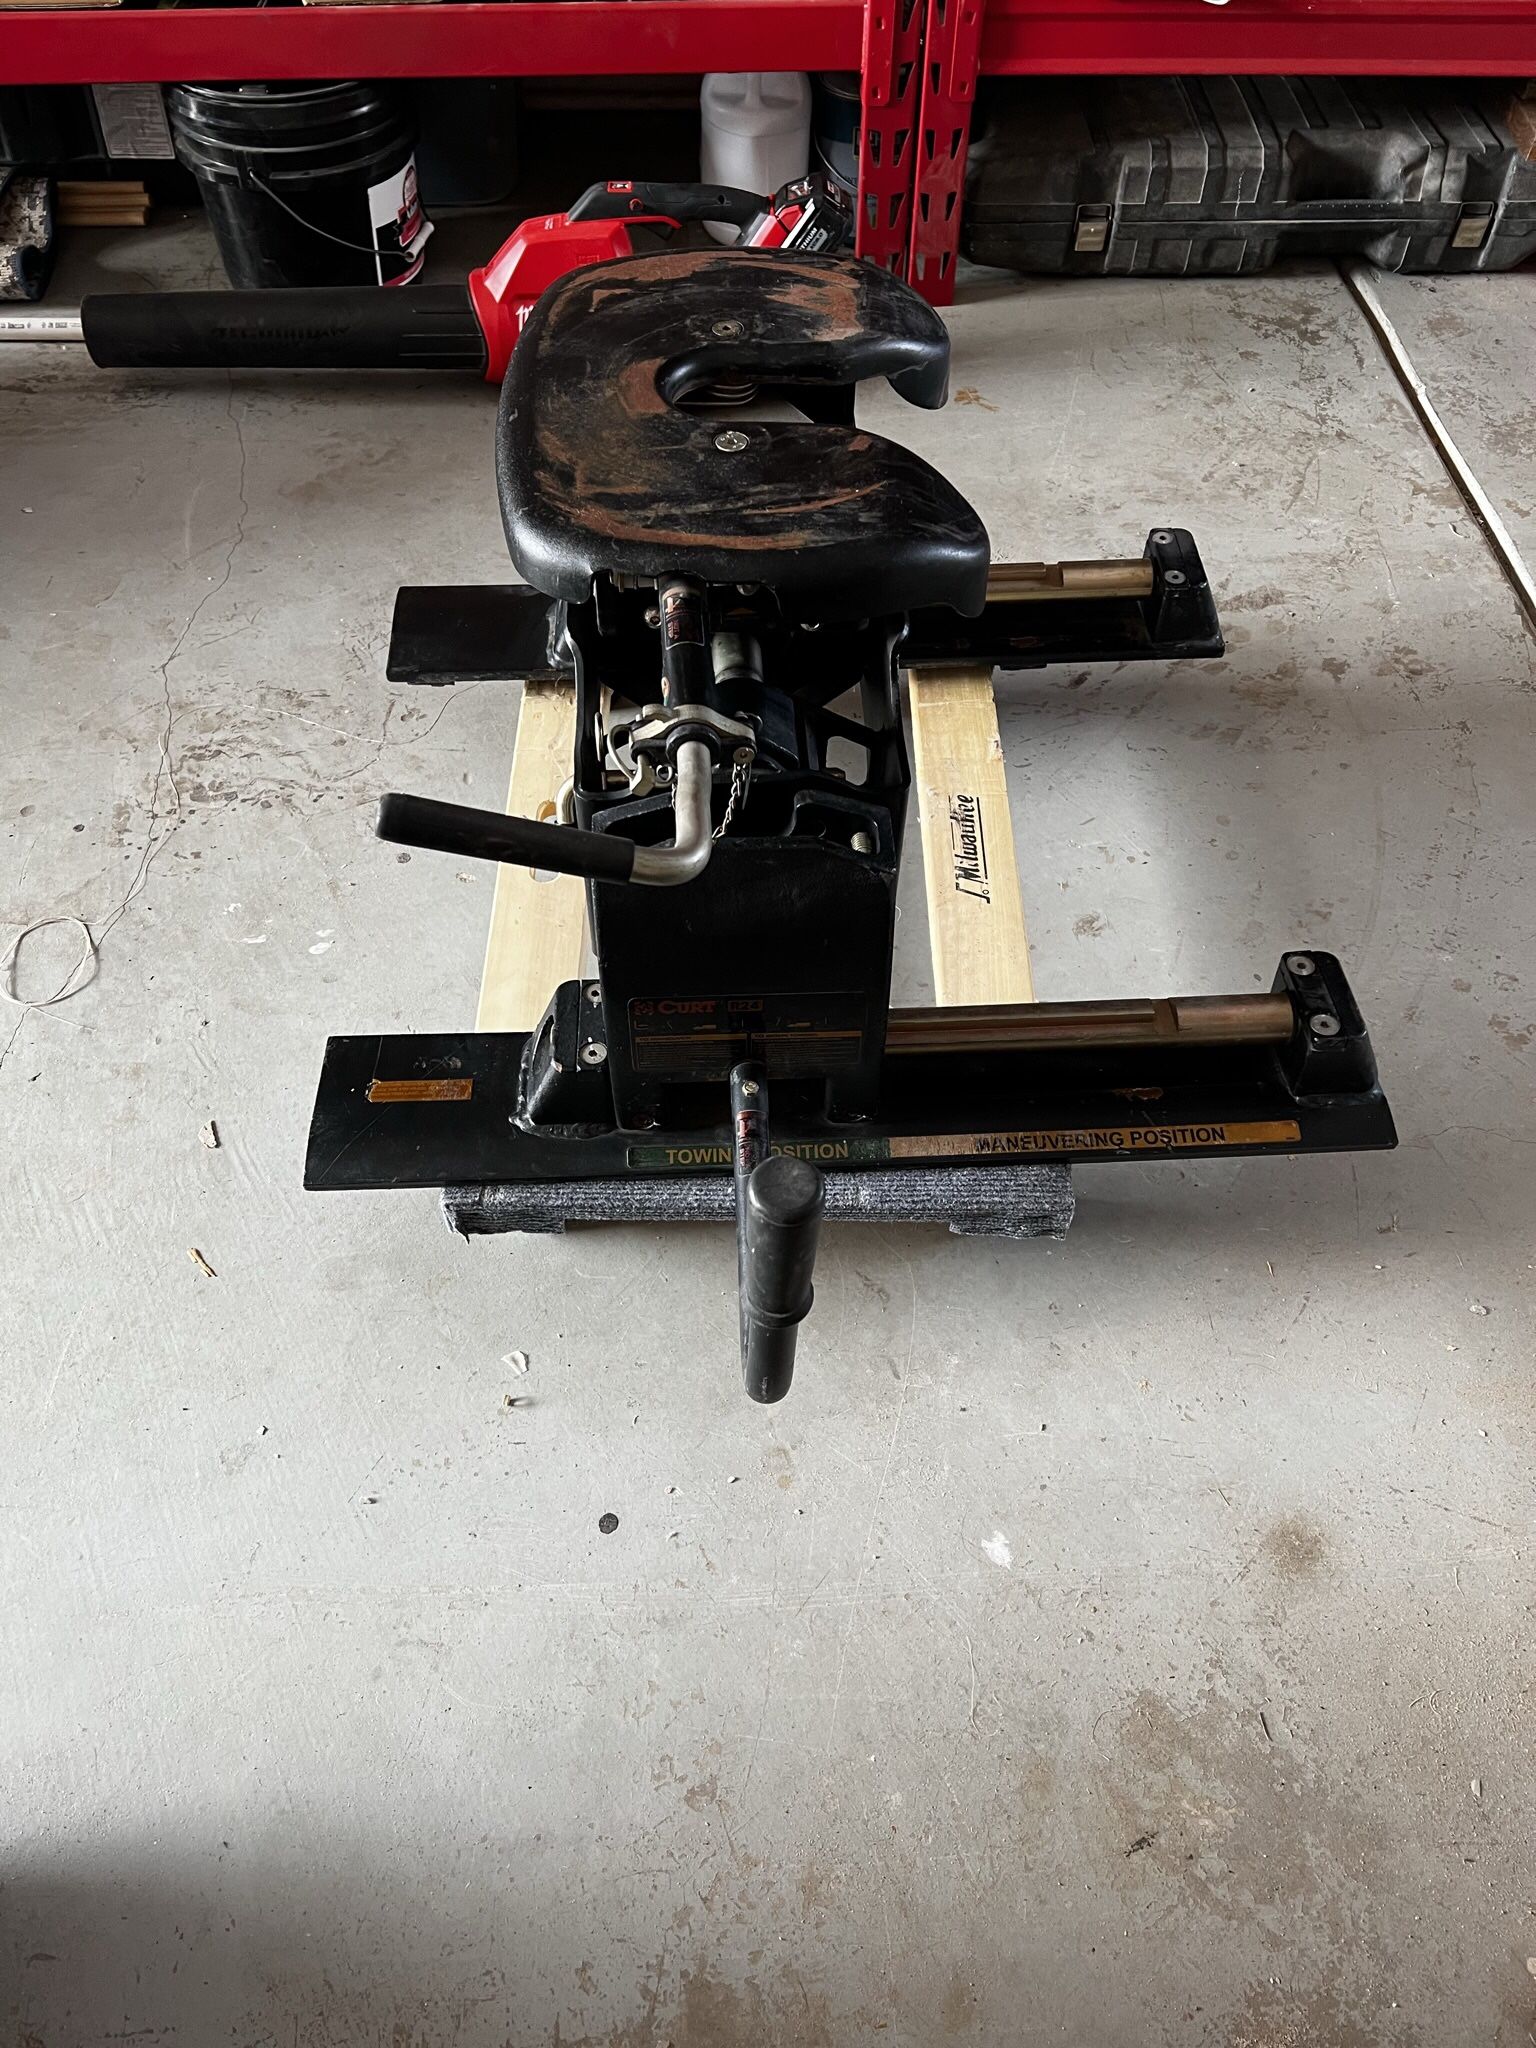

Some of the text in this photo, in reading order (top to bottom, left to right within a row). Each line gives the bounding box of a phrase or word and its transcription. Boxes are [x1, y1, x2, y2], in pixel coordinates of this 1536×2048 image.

[799, 227, 818, 250] THIUM
[658, 1000, 716, 1014] CURT
[976, 1127, 1225, 1151] MANEUVERING POSITION
[665, 1143, 849, 1164] TOWIN OSITION
